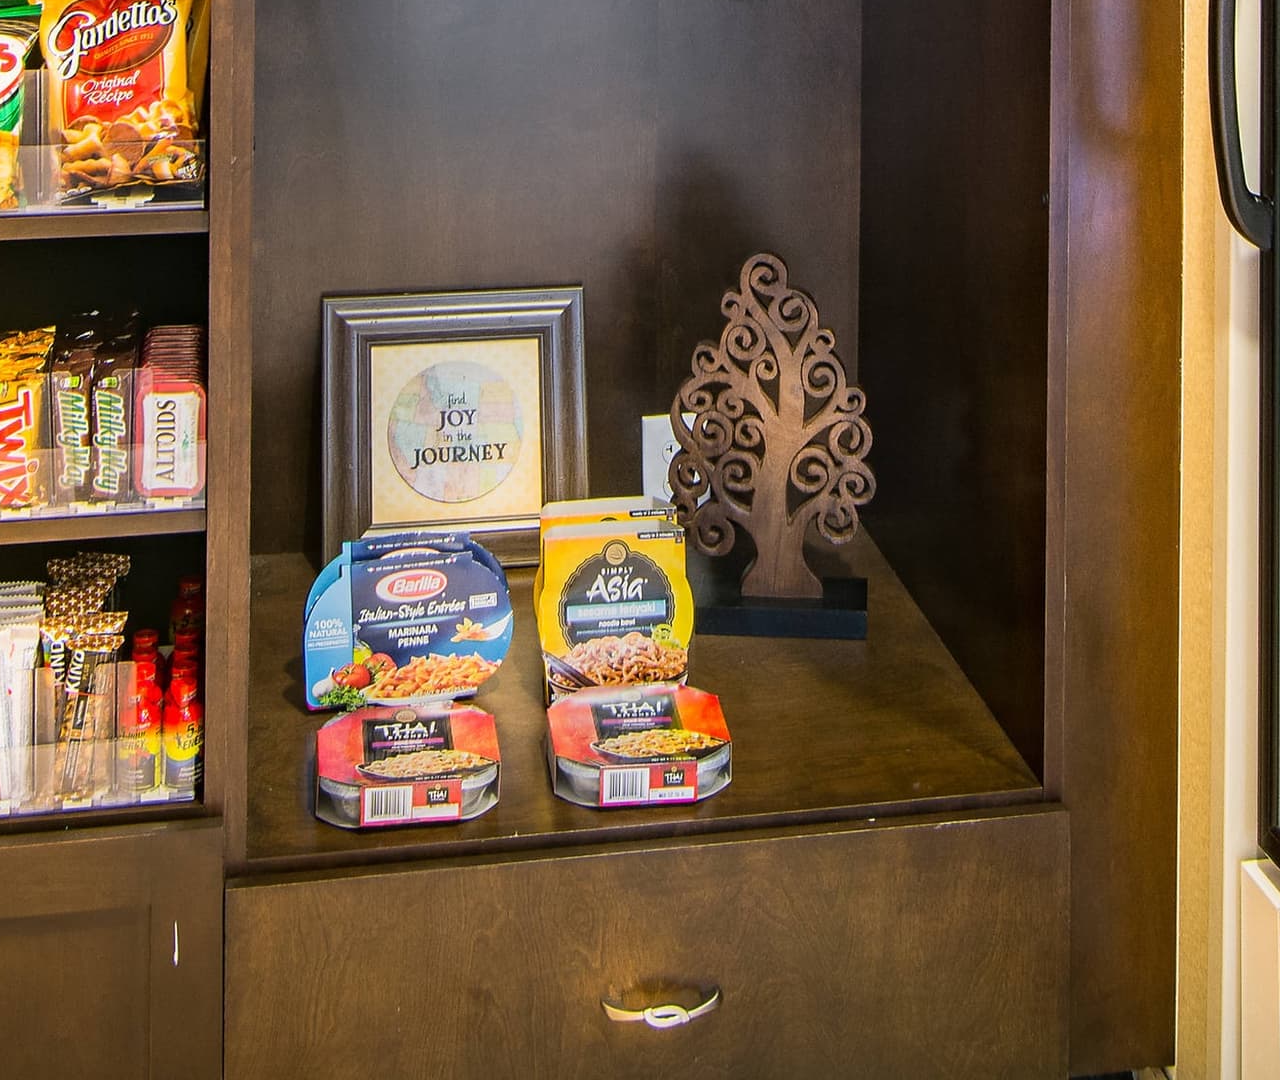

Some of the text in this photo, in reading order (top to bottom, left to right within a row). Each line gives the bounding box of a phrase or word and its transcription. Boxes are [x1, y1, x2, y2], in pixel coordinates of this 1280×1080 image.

[81, 70, 140, 94] Original
[87, 89, 134, 105] Recipe
[447, 392, 467, 408] find
[436, 409, 477, 432] JOY
[58, 391, 90, 488] Milky Way
[93, 391, 127, 494] Milky Way
[155, 399, 177, 484] ALTOIDS
[443, 431, 473, 442] in the
[411, 443, 507, 469] JOURNEY
[601, 566, 633, 576] SIMPLY
[393, 576, 442, 595] Barilla
[586, 575, 644, 603] Asia
[358, 600, 466, 623] Italian-Style Entrées
[577, 601, 656, 617] sesame teriyaki
[309, 627, 348, 637] NATURAL
[313, 618, 343, 630] 100%
[388, 624, 438, 639] MARINARA
[398, 636, 429, 648] PENNE
[52, 640, 65, 686] KIND
[66, 651, 86, 693] KIND
[602, 701, 663, 717] THAI
[374, 721, 436, 740] THAI
